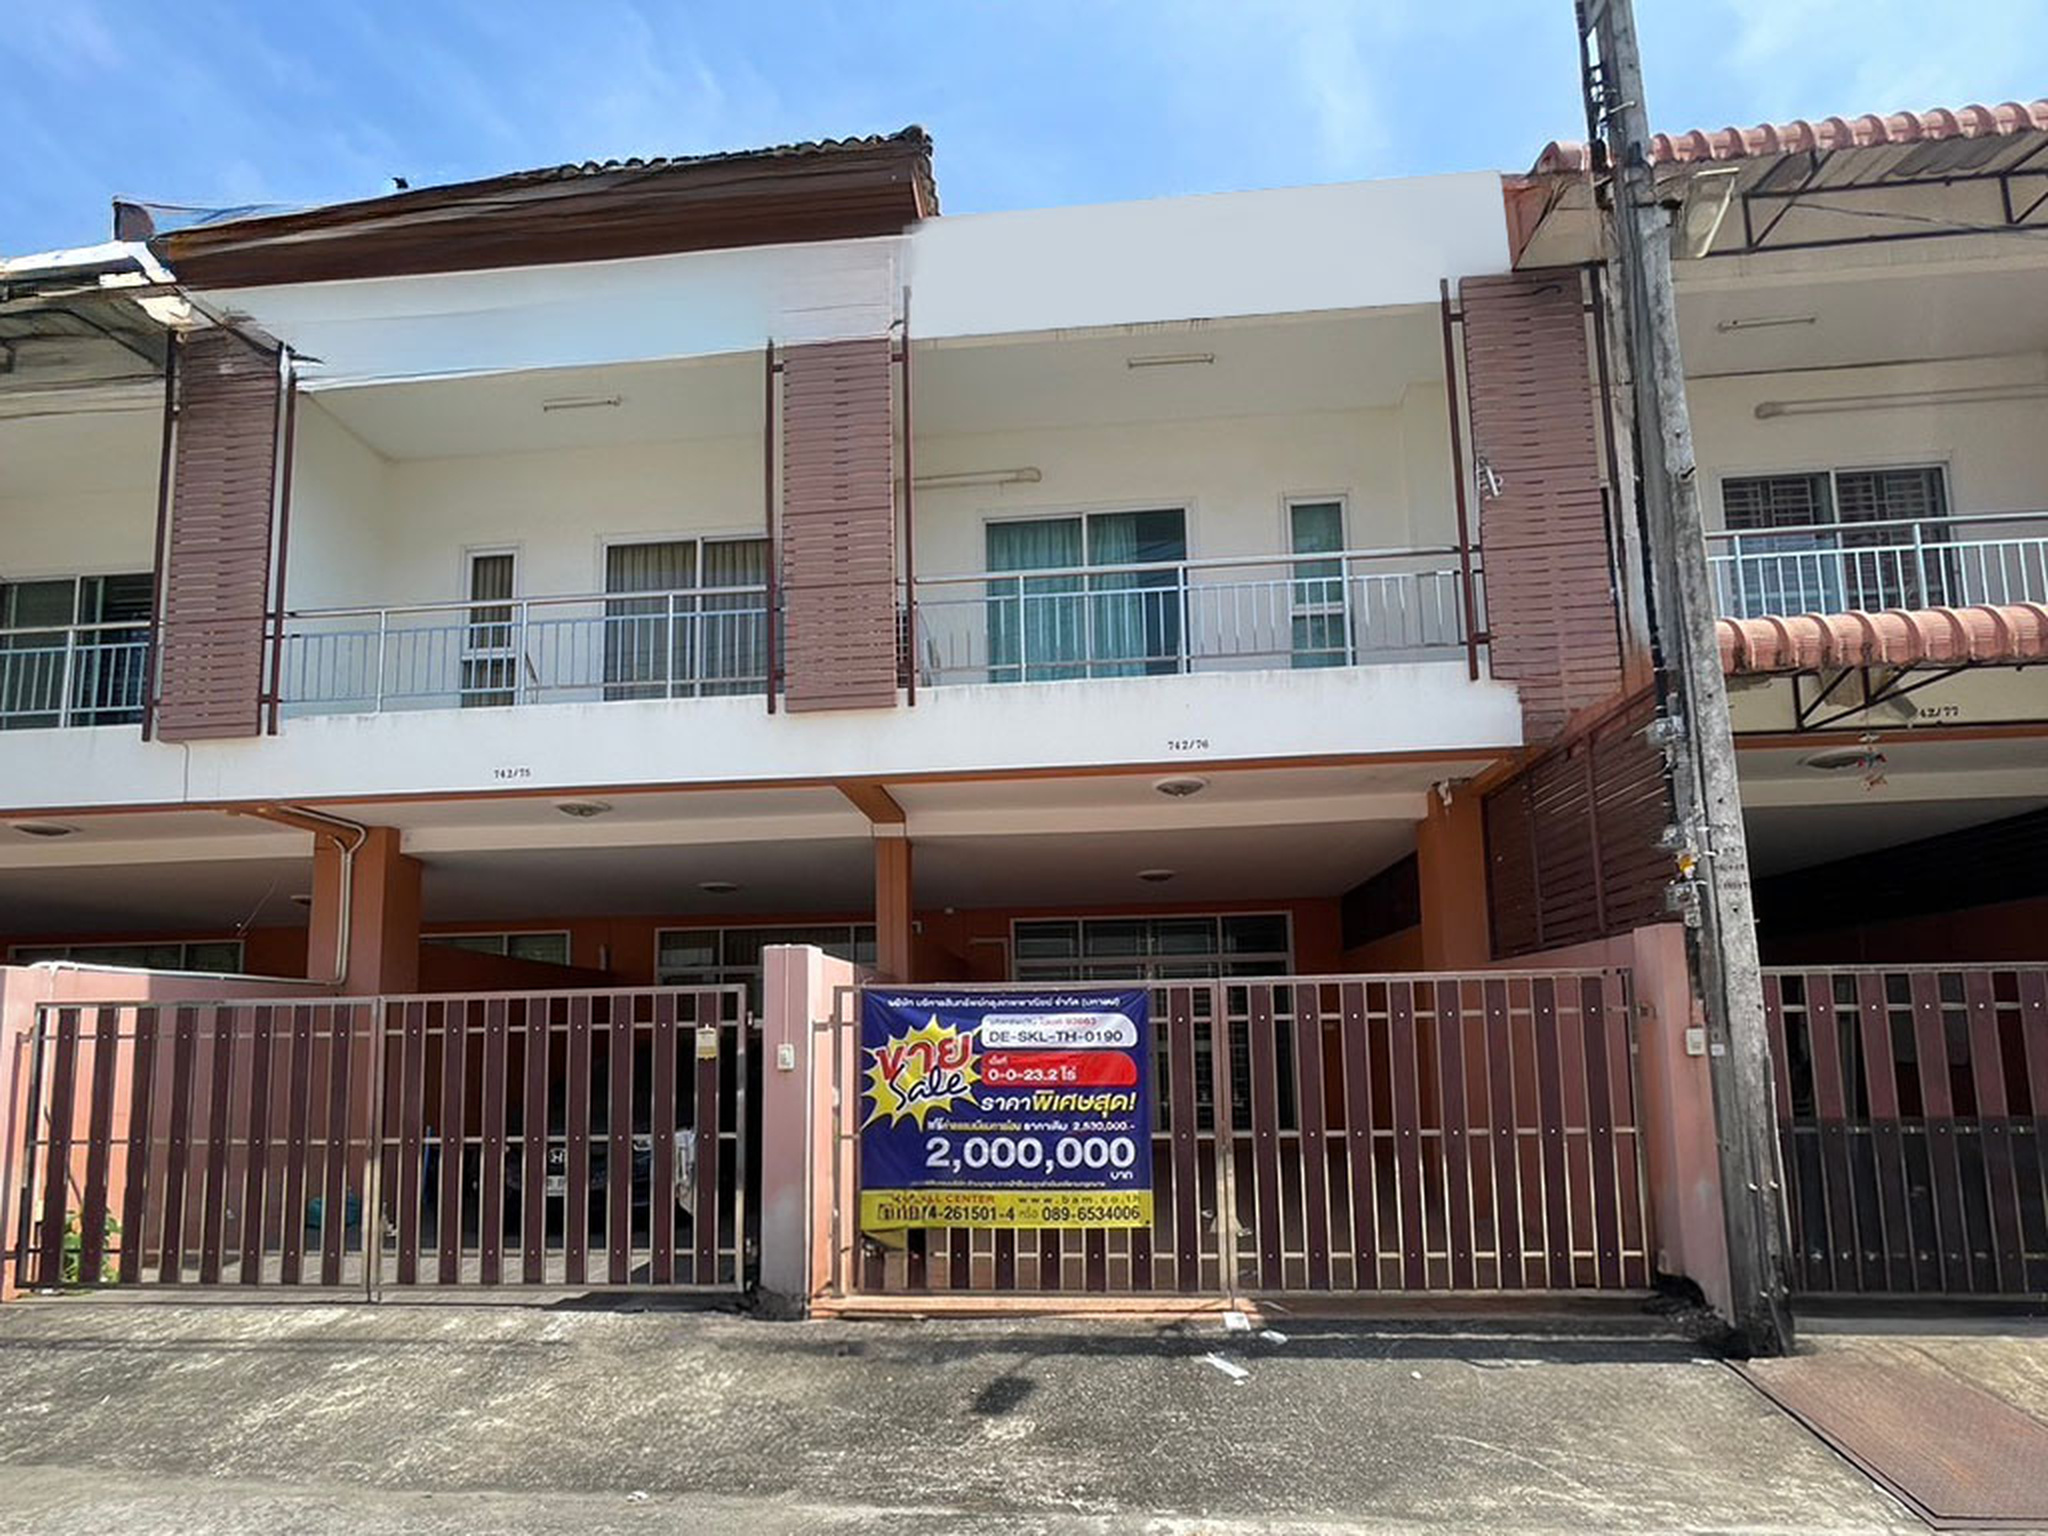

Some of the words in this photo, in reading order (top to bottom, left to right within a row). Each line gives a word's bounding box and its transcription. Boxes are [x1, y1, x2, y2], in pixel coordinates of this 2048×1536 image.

[1920, 706, 1959, 718] 42/77
[1167, 739, 1209, 750] 742/76
[494, 768, 531, 779] 742/75
[989, 1030, 1123, 1043] DE-SKL-TH-0190
[874, 1033, 972, 1082] ขาย
[987, 1068, 1058, 1081] 0-0-23.2
[889, 1063, 968, 1111] Sale
[925, 1136, 1136, 1173] 2,000,000
[1042, 1205, 1140, 1221] 089-6534006
